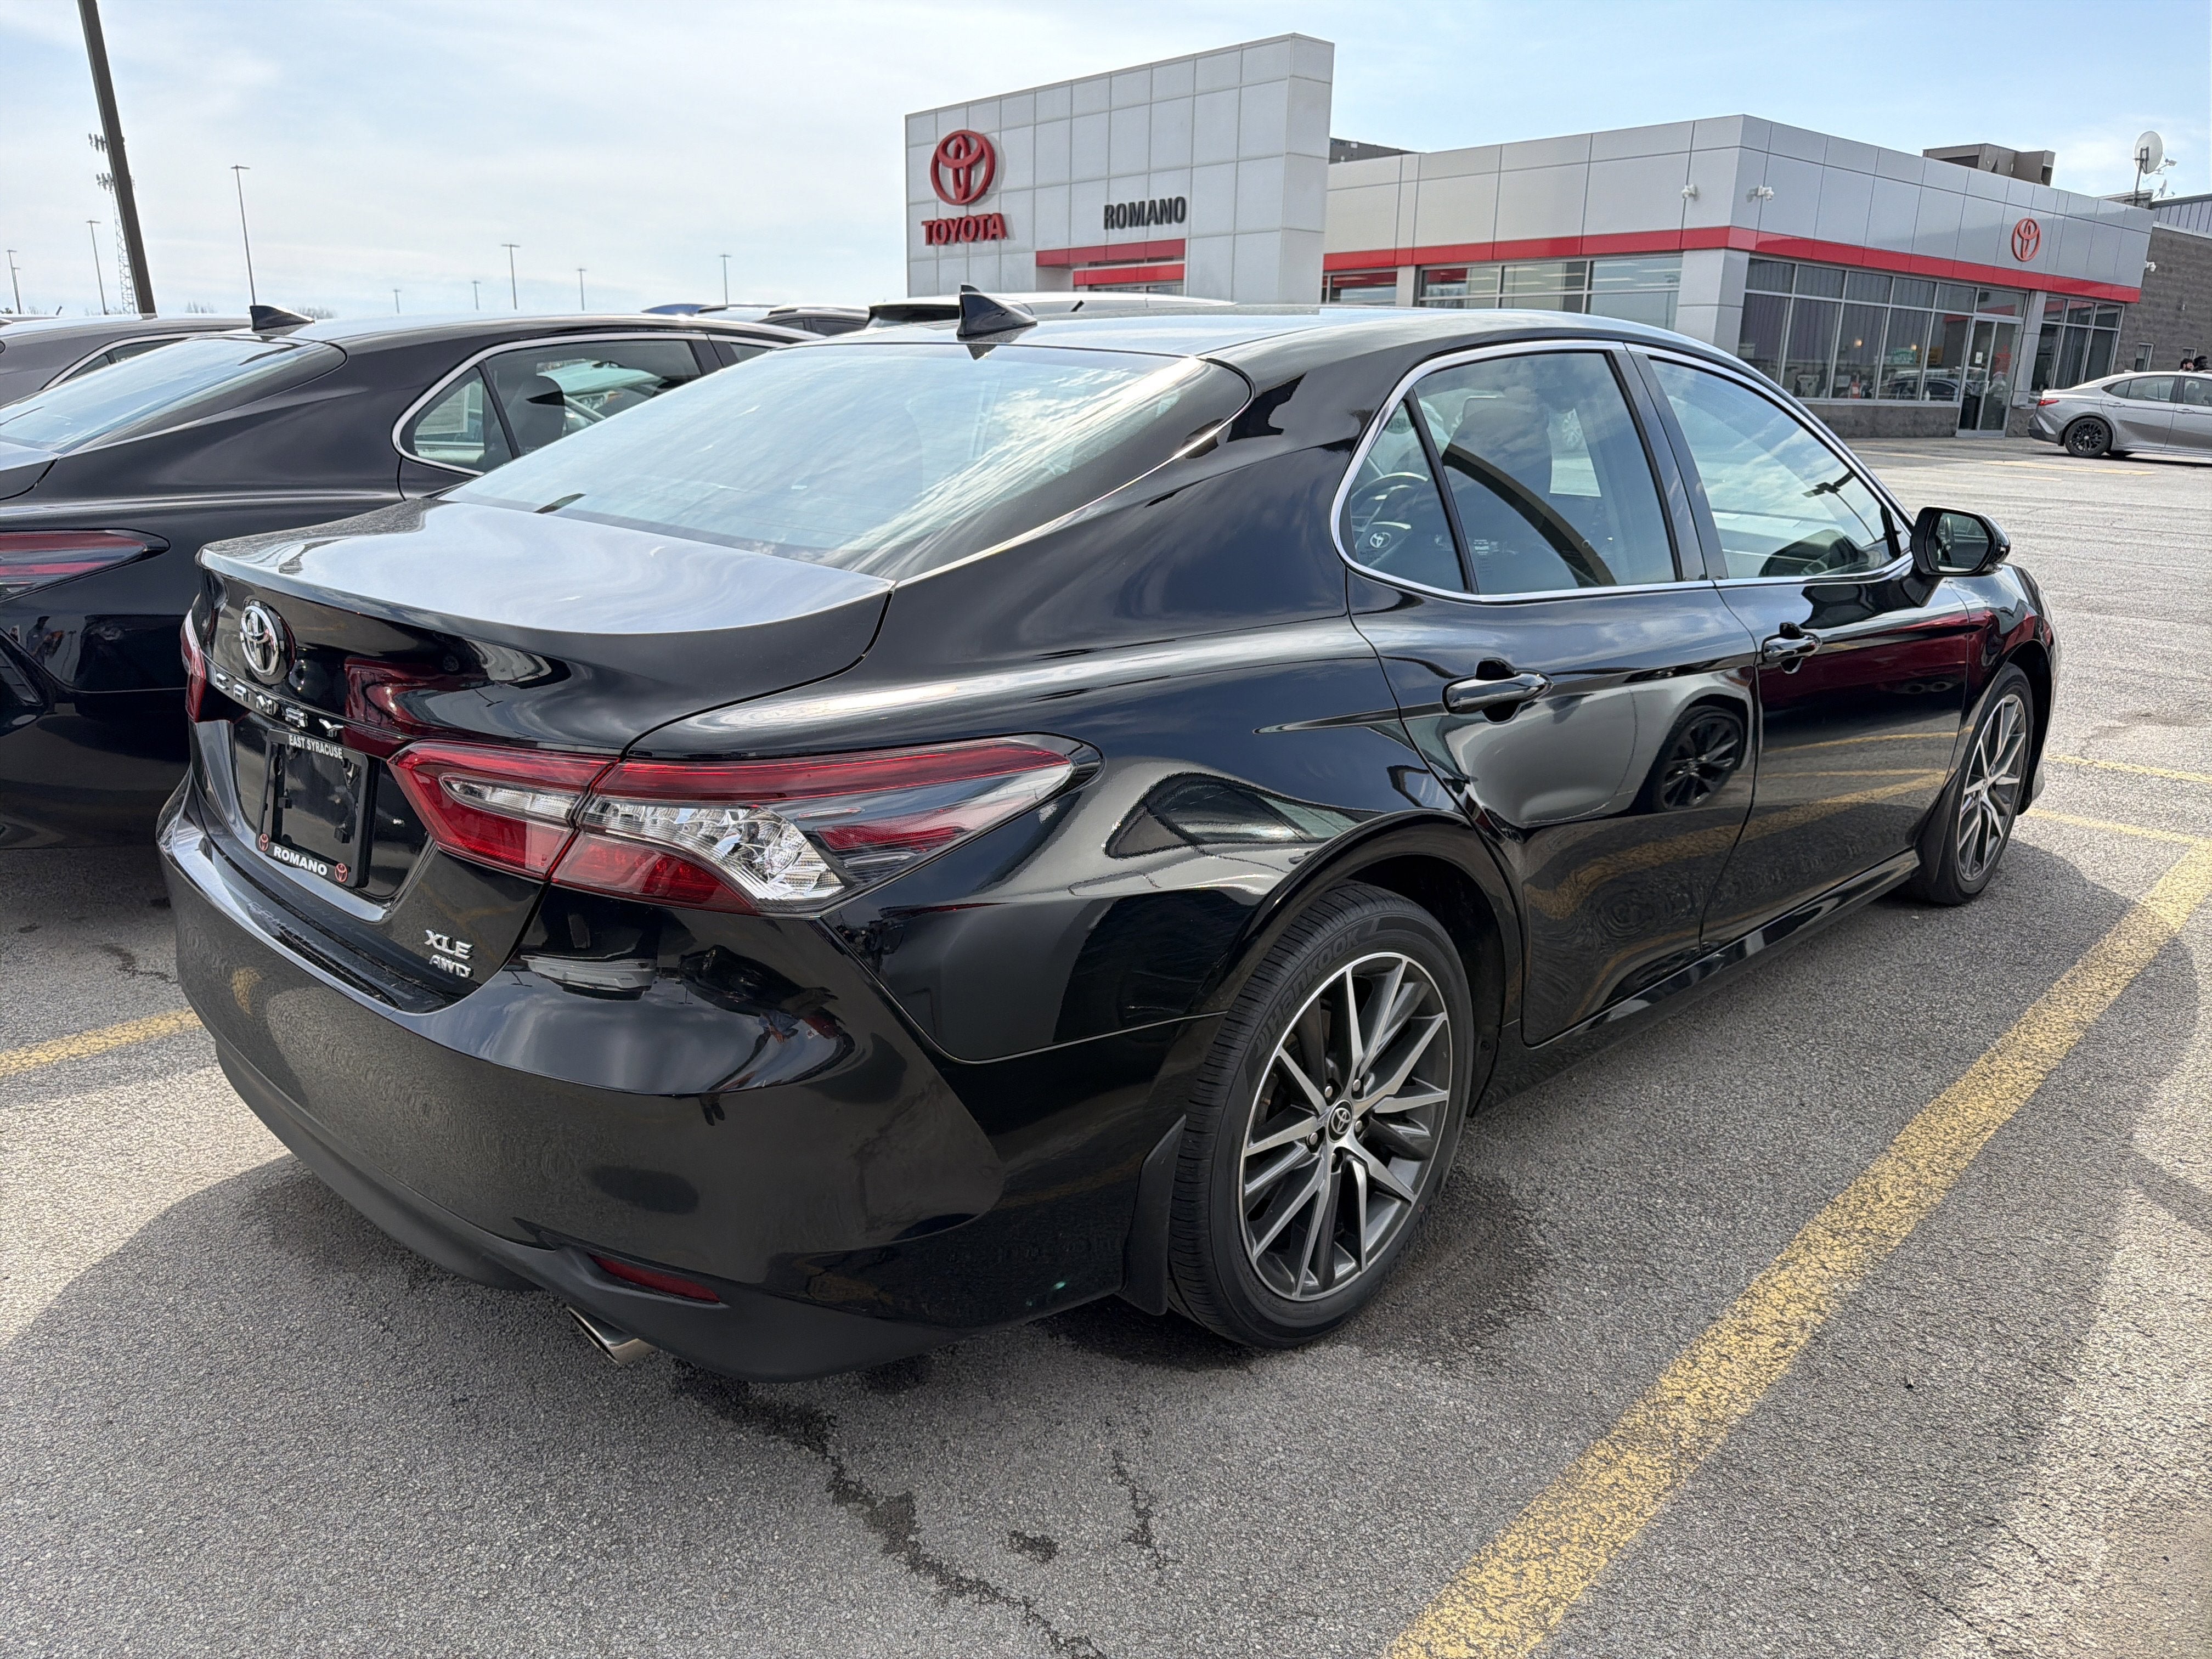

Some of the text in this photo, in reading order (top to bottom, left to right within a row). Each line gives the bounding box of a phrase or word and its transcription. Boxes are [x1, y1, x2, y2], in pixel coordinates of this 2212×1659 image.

[1103, 196, 1186, 229] ROMANO
[922, 213, 1006, 245] TOYOTA
[216, 673, 345, 737] CAMRY
[288, 734, 343, 759] EAST SYRACUSE
[273, 845, 328, 876] ROMANO
[424, 929, 473, 960] XLE
[428, 954, 472, 978] AWD
